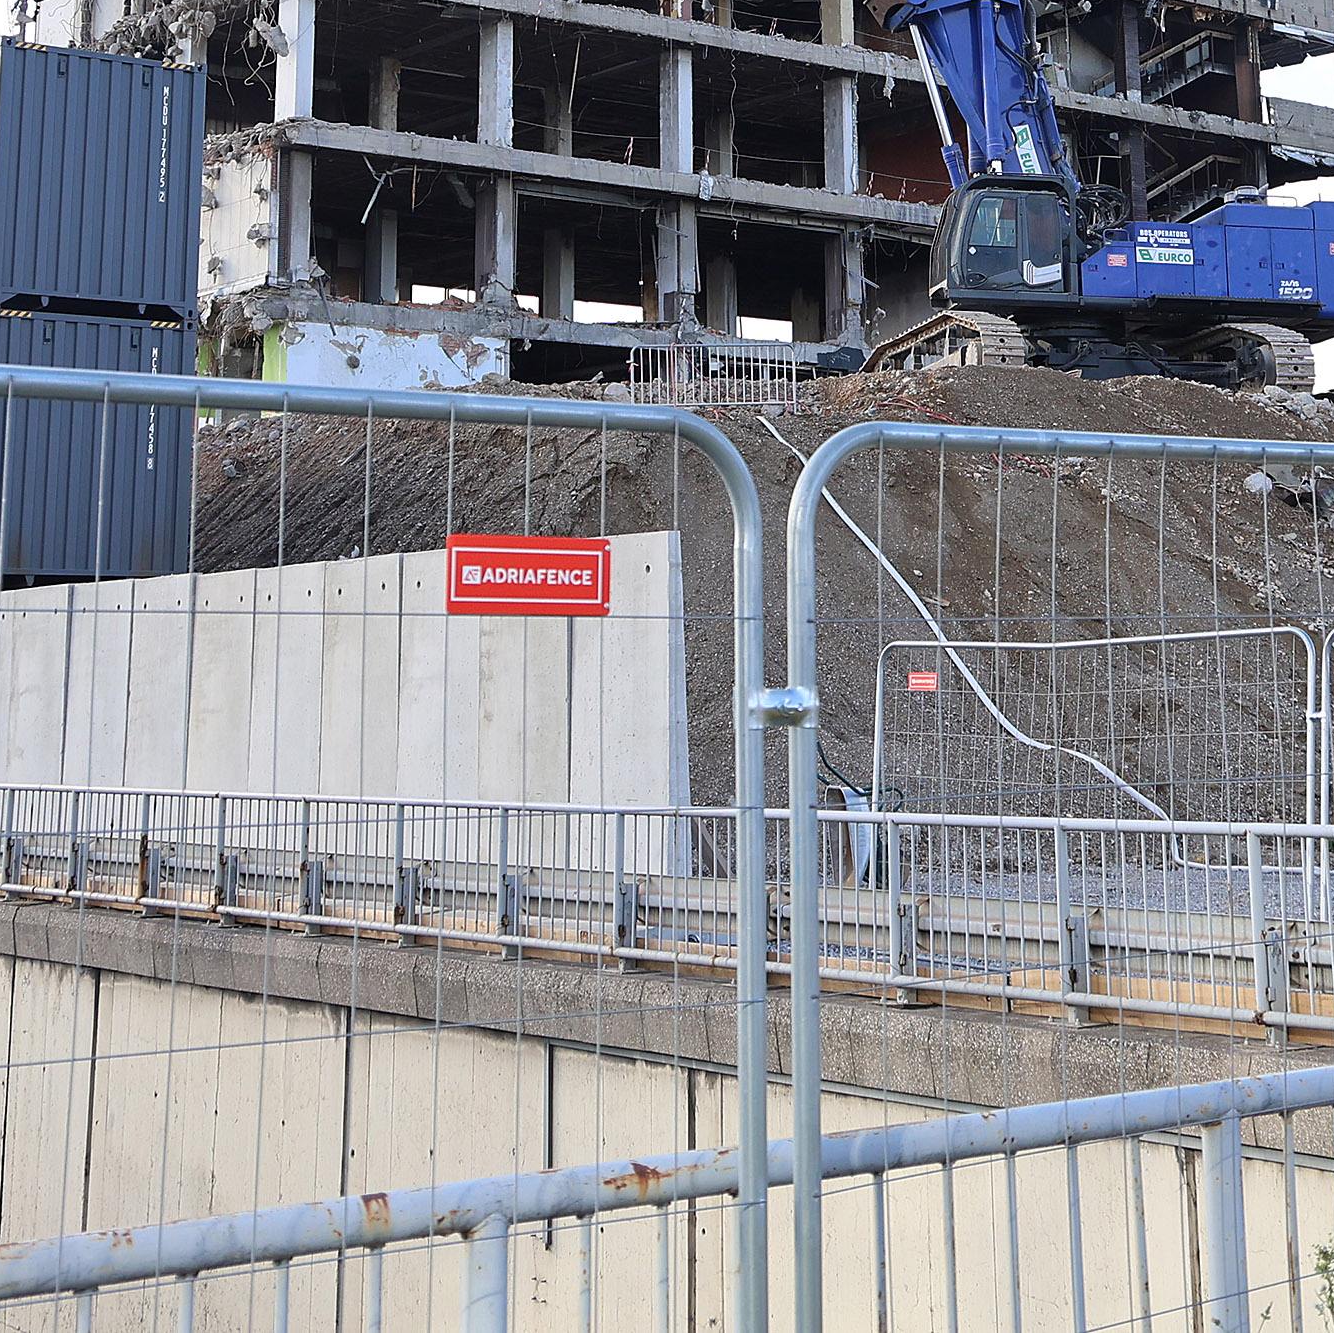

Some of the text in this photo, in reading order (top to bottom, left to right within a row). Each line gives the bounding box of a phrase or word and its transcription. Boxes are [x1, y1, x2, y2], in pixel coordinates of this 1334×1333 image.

[157, 86, 170, 203] MCDU 177495 2
[1158, 252, 1192, 263] EURCO
[1278, 287, 1314, 300] 1500
[482, 567, 593, 586] ADRIAFENCE
